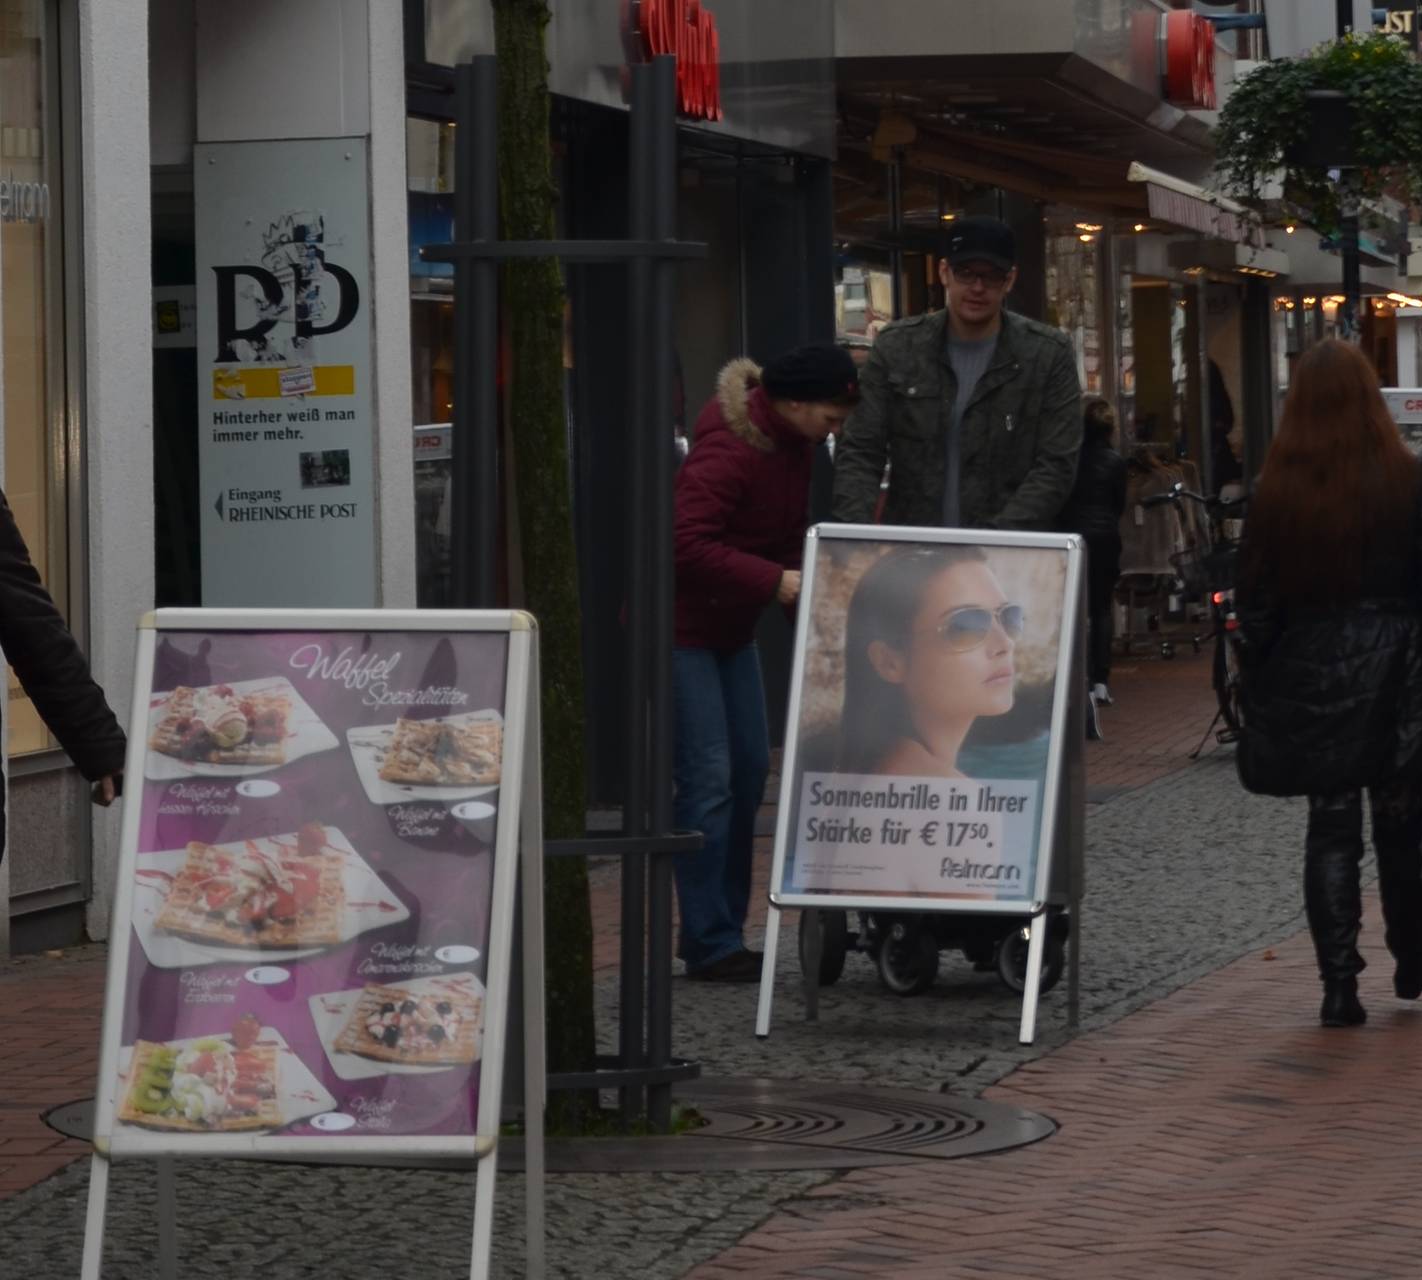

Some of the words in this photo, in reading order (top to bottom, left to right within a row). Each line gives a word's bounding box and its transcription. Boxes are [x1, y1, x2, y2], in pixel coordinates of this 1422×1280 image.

[213, 410, 282, 425] Hinterher
[287, 408, 320, 422] weiß
[325, 410, 355, 421] man
[213, 429, 259, 443] immer
[263, 427, 304, 441] mehr.
[228, 488, 282, 503] Eingang
[229, 505, 316, 523] RHEINISCHE
[320, 504, 358, 519] POST
[289, 644, 402, 690] Waffel
[809, 780, 940, 811] Sonnenbrille
[949, 787, 968, 813] in
[976, 786, 1029, 814] Ihrer
[806, 816, 872, 845] Stärke
[880, 818, 912, 846] für
[919, 821, 940, 847] €
